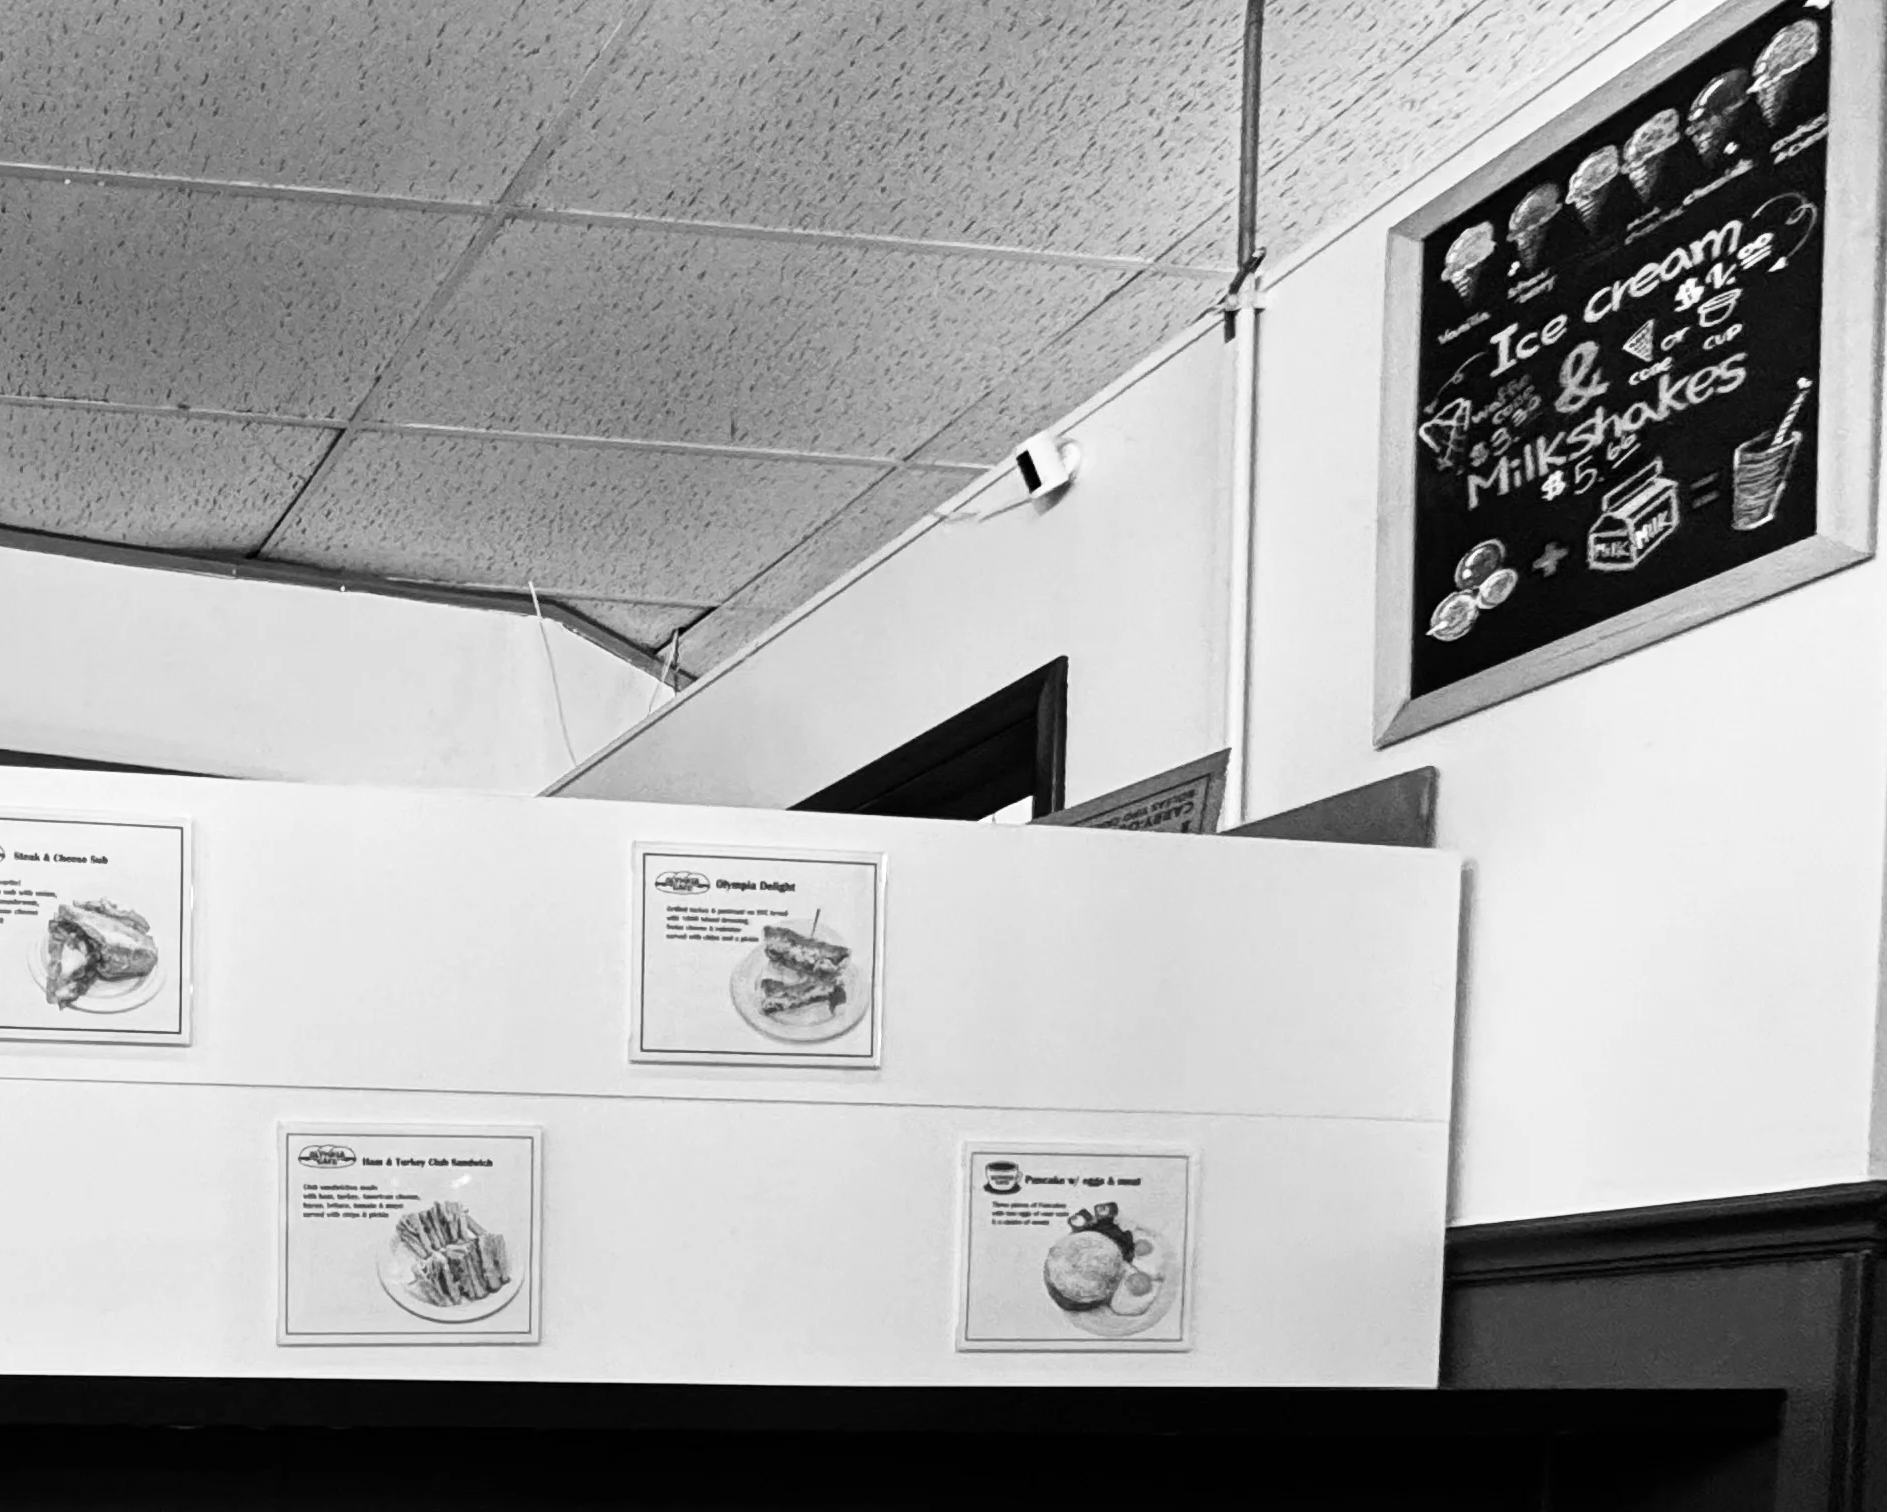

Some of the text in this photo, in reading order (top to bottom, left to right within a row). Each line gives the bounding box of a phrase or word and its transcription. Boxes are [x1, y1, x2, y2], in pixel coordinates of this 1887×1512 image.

[1489, 314, 1568, 378] Ice
[1554, 341, 1611, 413] &
[14, 851, 108, 864] Steak & Cheese Sub
[716, 879, 796, 893] Olympia Delight
[362, 1157, 493, 1168] Ham & Turkey Club Sandwich
